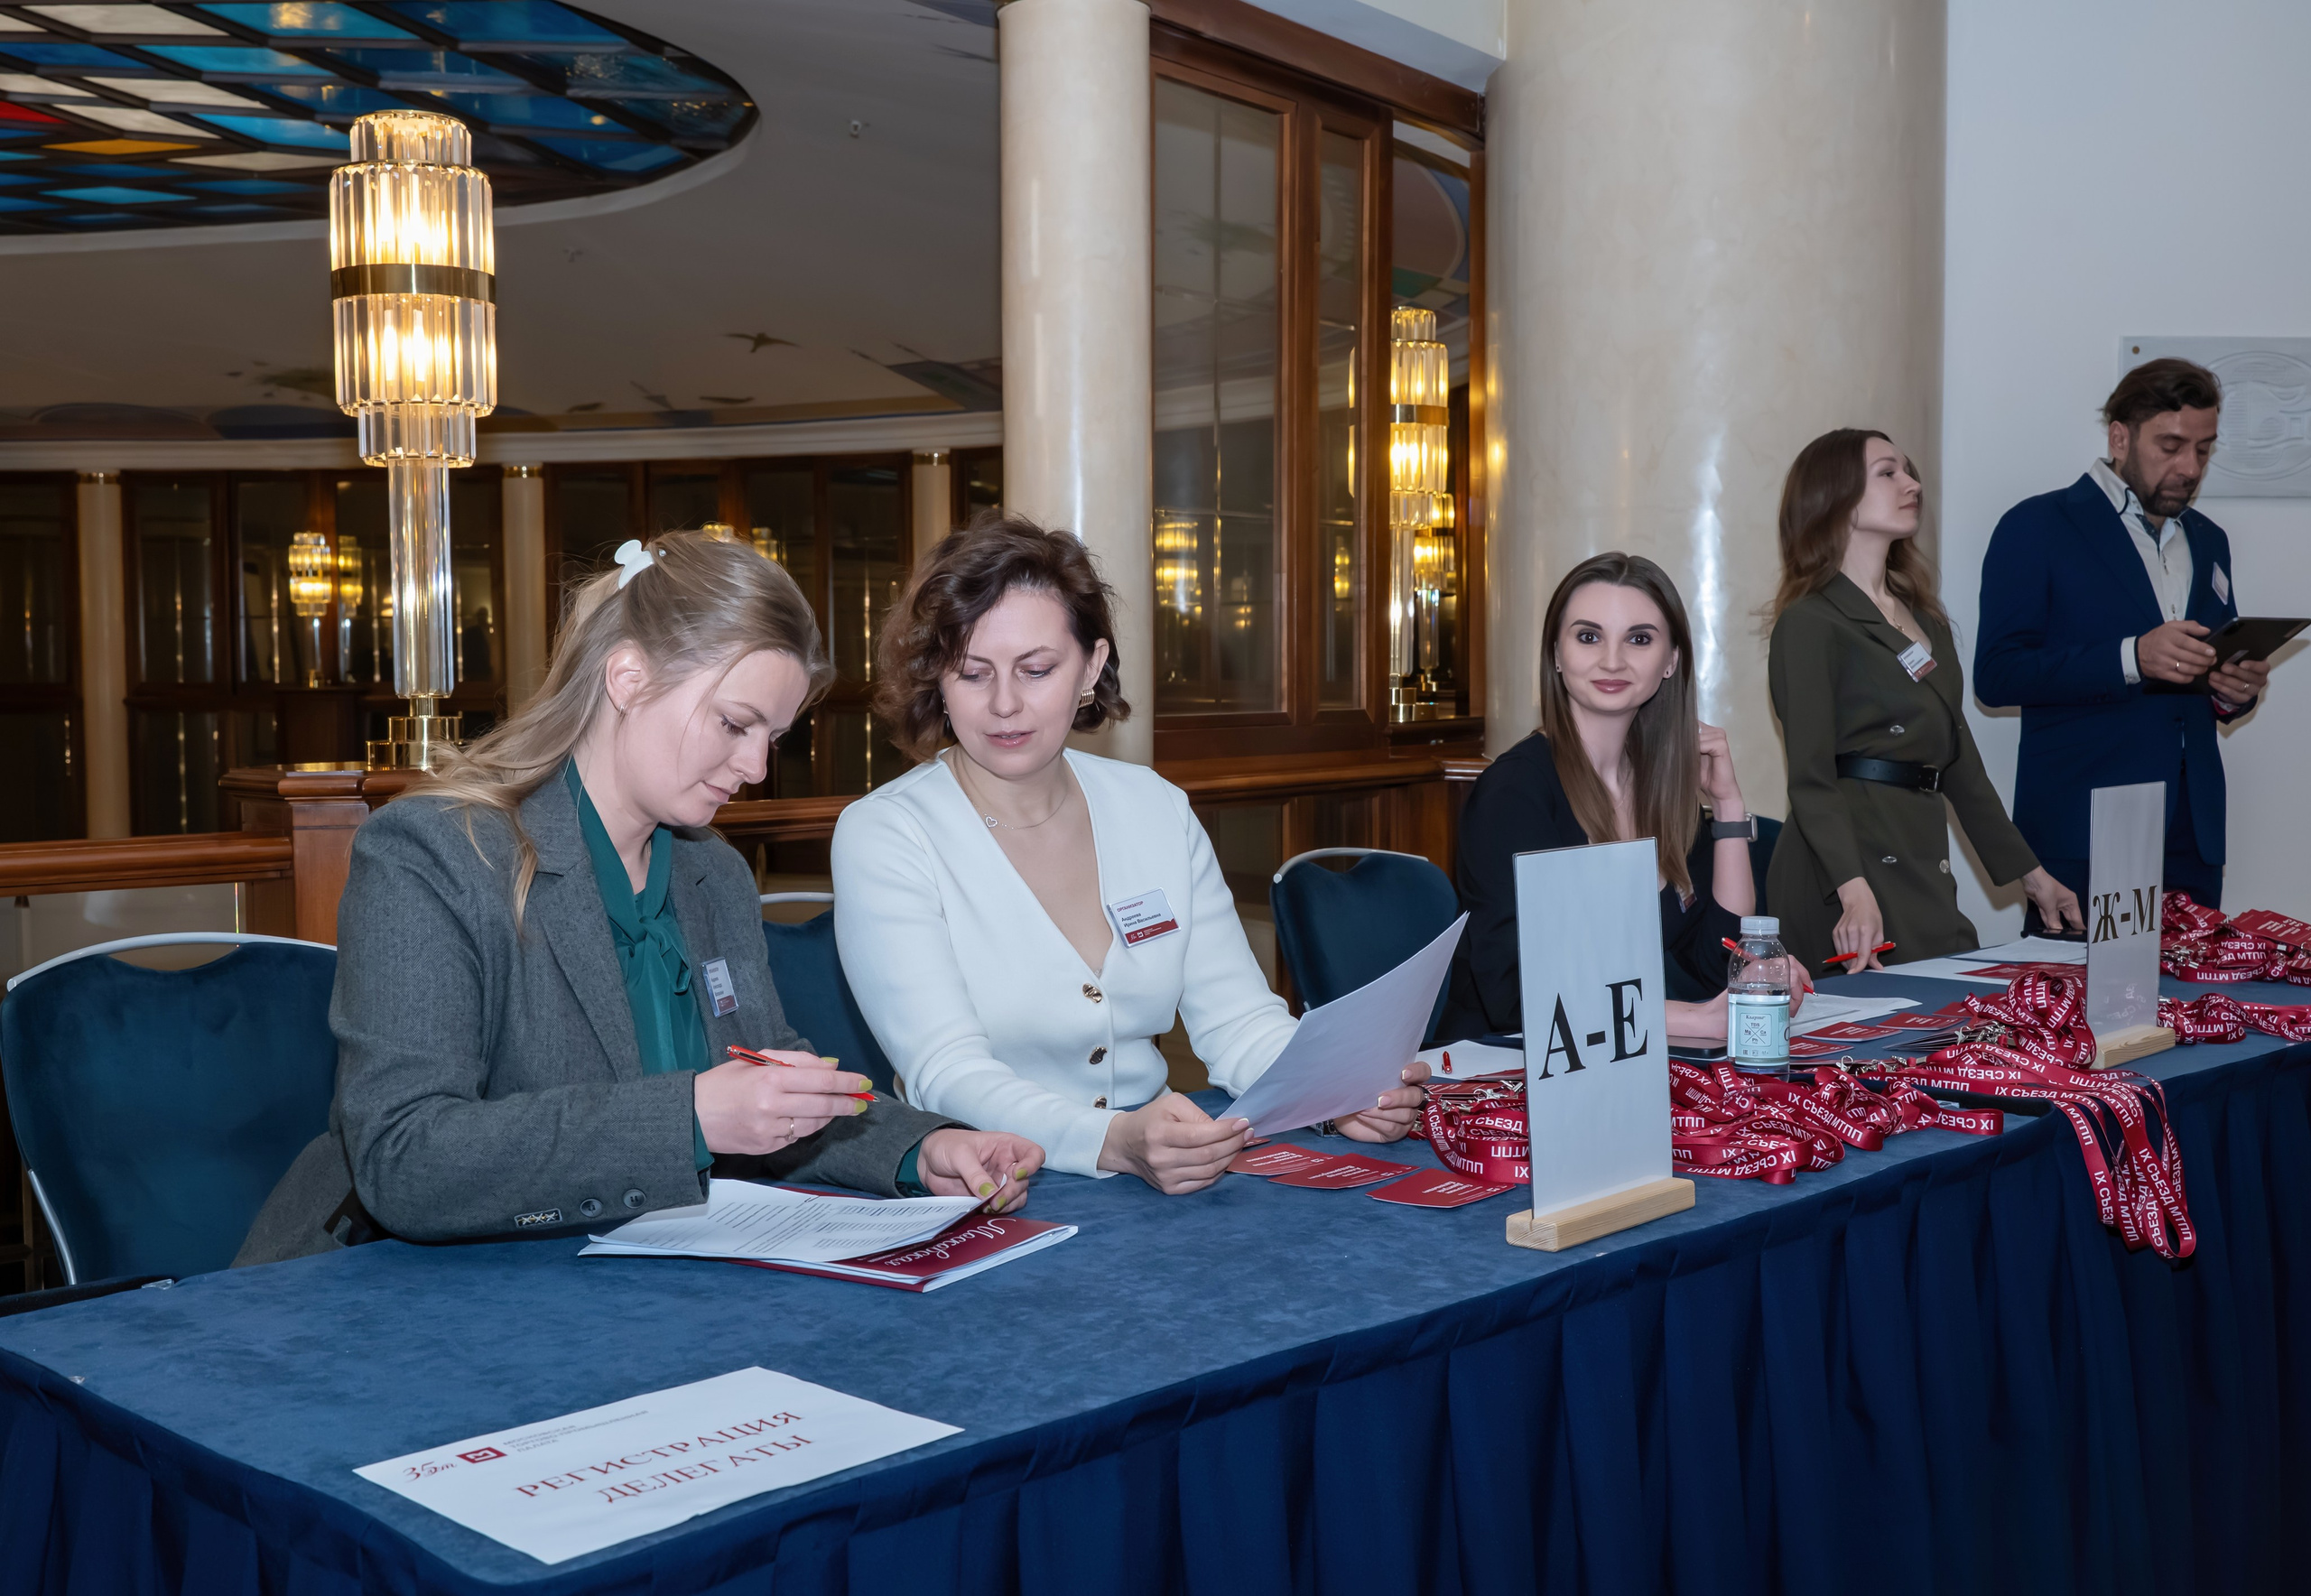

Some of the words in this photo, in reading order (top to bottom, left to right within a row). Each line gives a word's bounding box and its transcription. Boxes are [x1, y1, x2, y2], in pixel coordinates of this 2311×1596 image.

[2092, 886, 2158, 944] Ж-М
[2196, 971, 2229, 981] МТПП
[2046, 998, 2073, 1029] МТПП
[1538, 978, 1648, 1081] А-Е
[1985, 1044, 2030, 1066] СЪЕЗД
[1957, 1065, 2005, 1081] СЪЕЗД
[2008, 1071, 2021, 1081] IX
[2031, 1062, 2046, 1074] IX
[1697, 1076, 1712, 1086] IX
[1427, 1104, 1437, 1116] IX
[1994, 1086, 2007, 1096] IX
[2010, 1088, 2057, 1100] СЪЕЗД
[2060, 1092, 2101, 1113] МТПП
[1788, 1092, 1801, 1106] IX
[1803, 1099, 1833, 1126] СЪЕЗД
[1831, 1118, 1864, 1142] МТПП
[2103, 1094, 2135, 1128] МТПП
[1475, 1116, 1523, 1134] СЪЕЗД
[1980, 1119, 1994, 1130] IX
[2066, 1106, 2094, 1146] МТПП
[1722, 1148, 1737, 1159] IX
[1779, 1150, 1796, 1165] IX
[1455, 1156, 1483, 1174] МТПП
[1514, 1165, 1529, 1178] IX
[1734, 1155, 1777, 1176] СЪЕЗД
[2094, 1171, 2107, 1185] IX
[2139, 1147, 2153, 1163] IX
[2147, 1163, 2176, 1206] СЪЕЗД
[2168, 1205, 2193, 1240] МТПП
[2120, 1205, 2140, 1241] МТПП
[2145, 1199, 2164, 1247] СЪЕЗД
[885, 1218, 1016, 1267] Московская
[515, 1411, 806, 1498] РЕГИСТРАЦИЯ
[596, 1434, 814, 1504] ДЕЛЕГАТЫ
